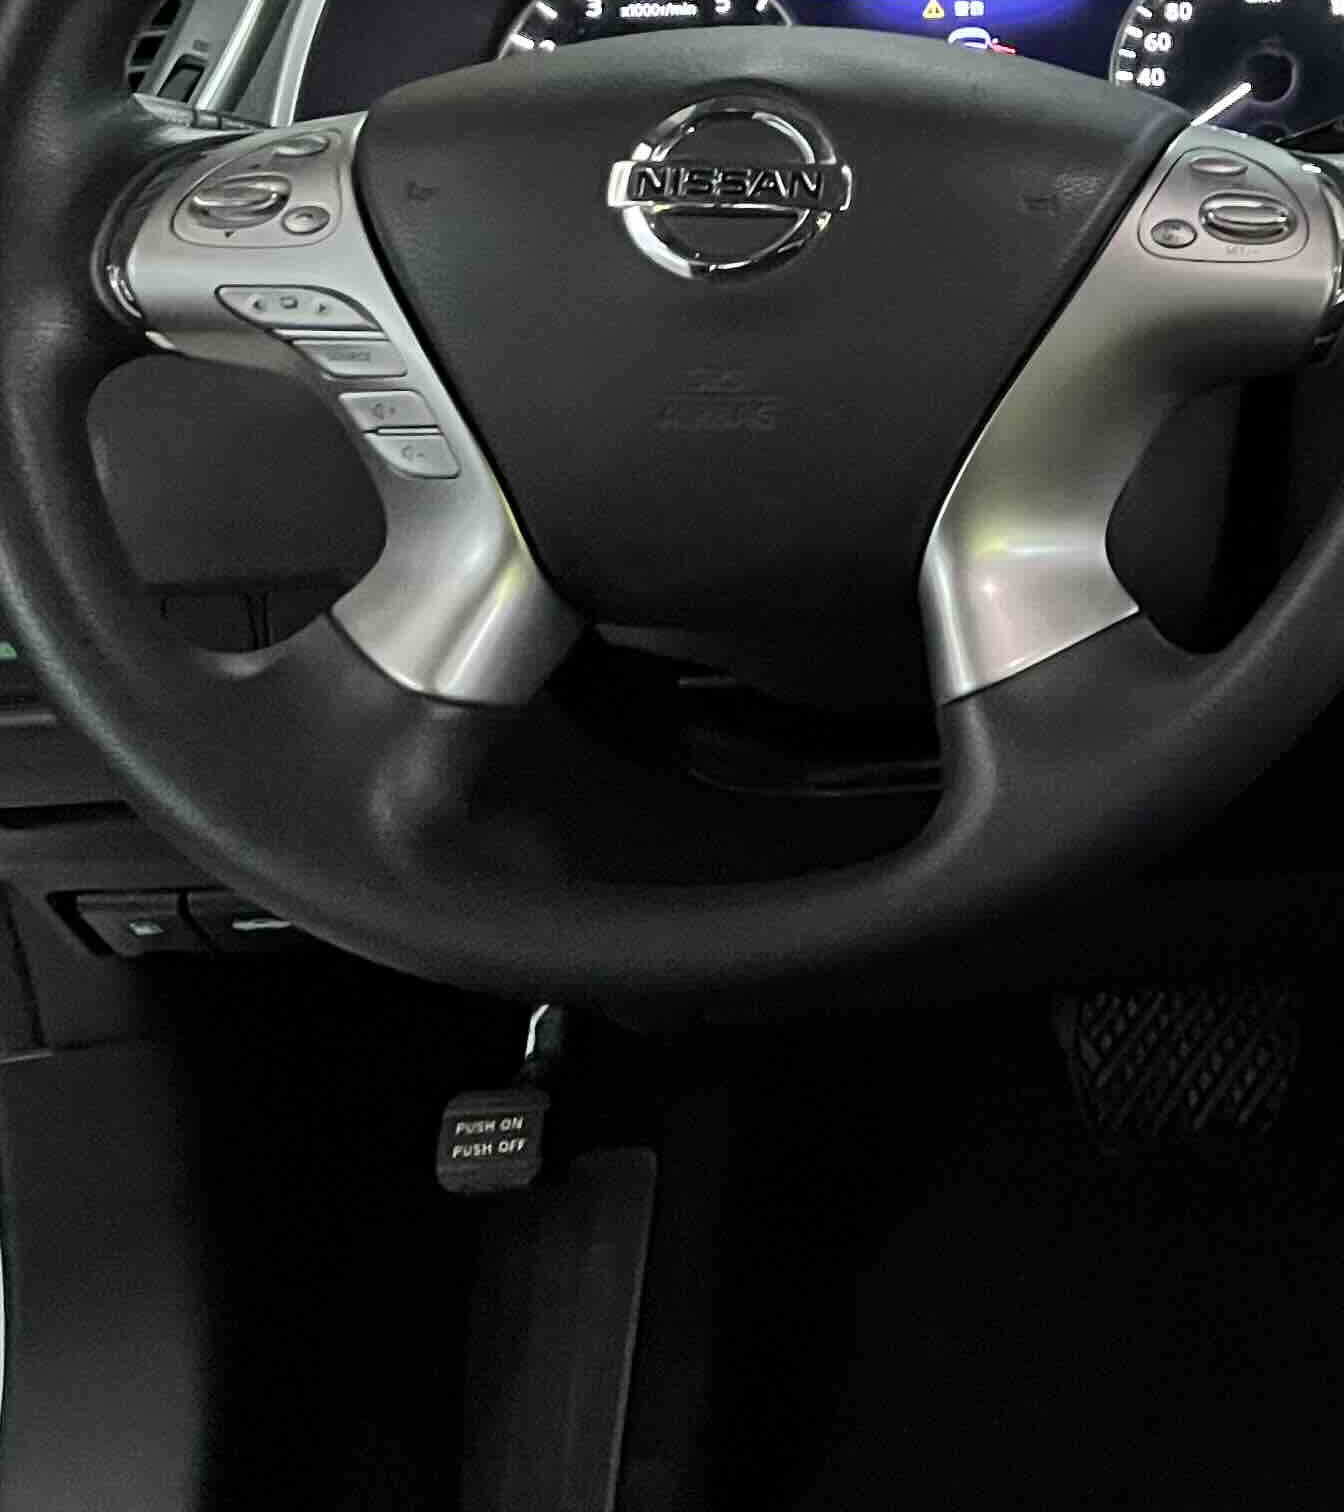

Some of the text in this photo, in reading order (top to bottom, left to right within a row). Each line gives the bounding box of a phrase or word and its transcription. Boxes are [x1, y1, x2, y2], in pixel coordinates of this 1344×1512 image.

[1164, 2, 1193, 22] 80
[1143, 31, 1173, 52] 60
[1136, 67, 1166, 87] 40
[637, 167, 825, 199] NISSAN
[455, 1116, 525, 1136] PUSH ON
[451, 1138, 526, 1159] PUSH OFF
